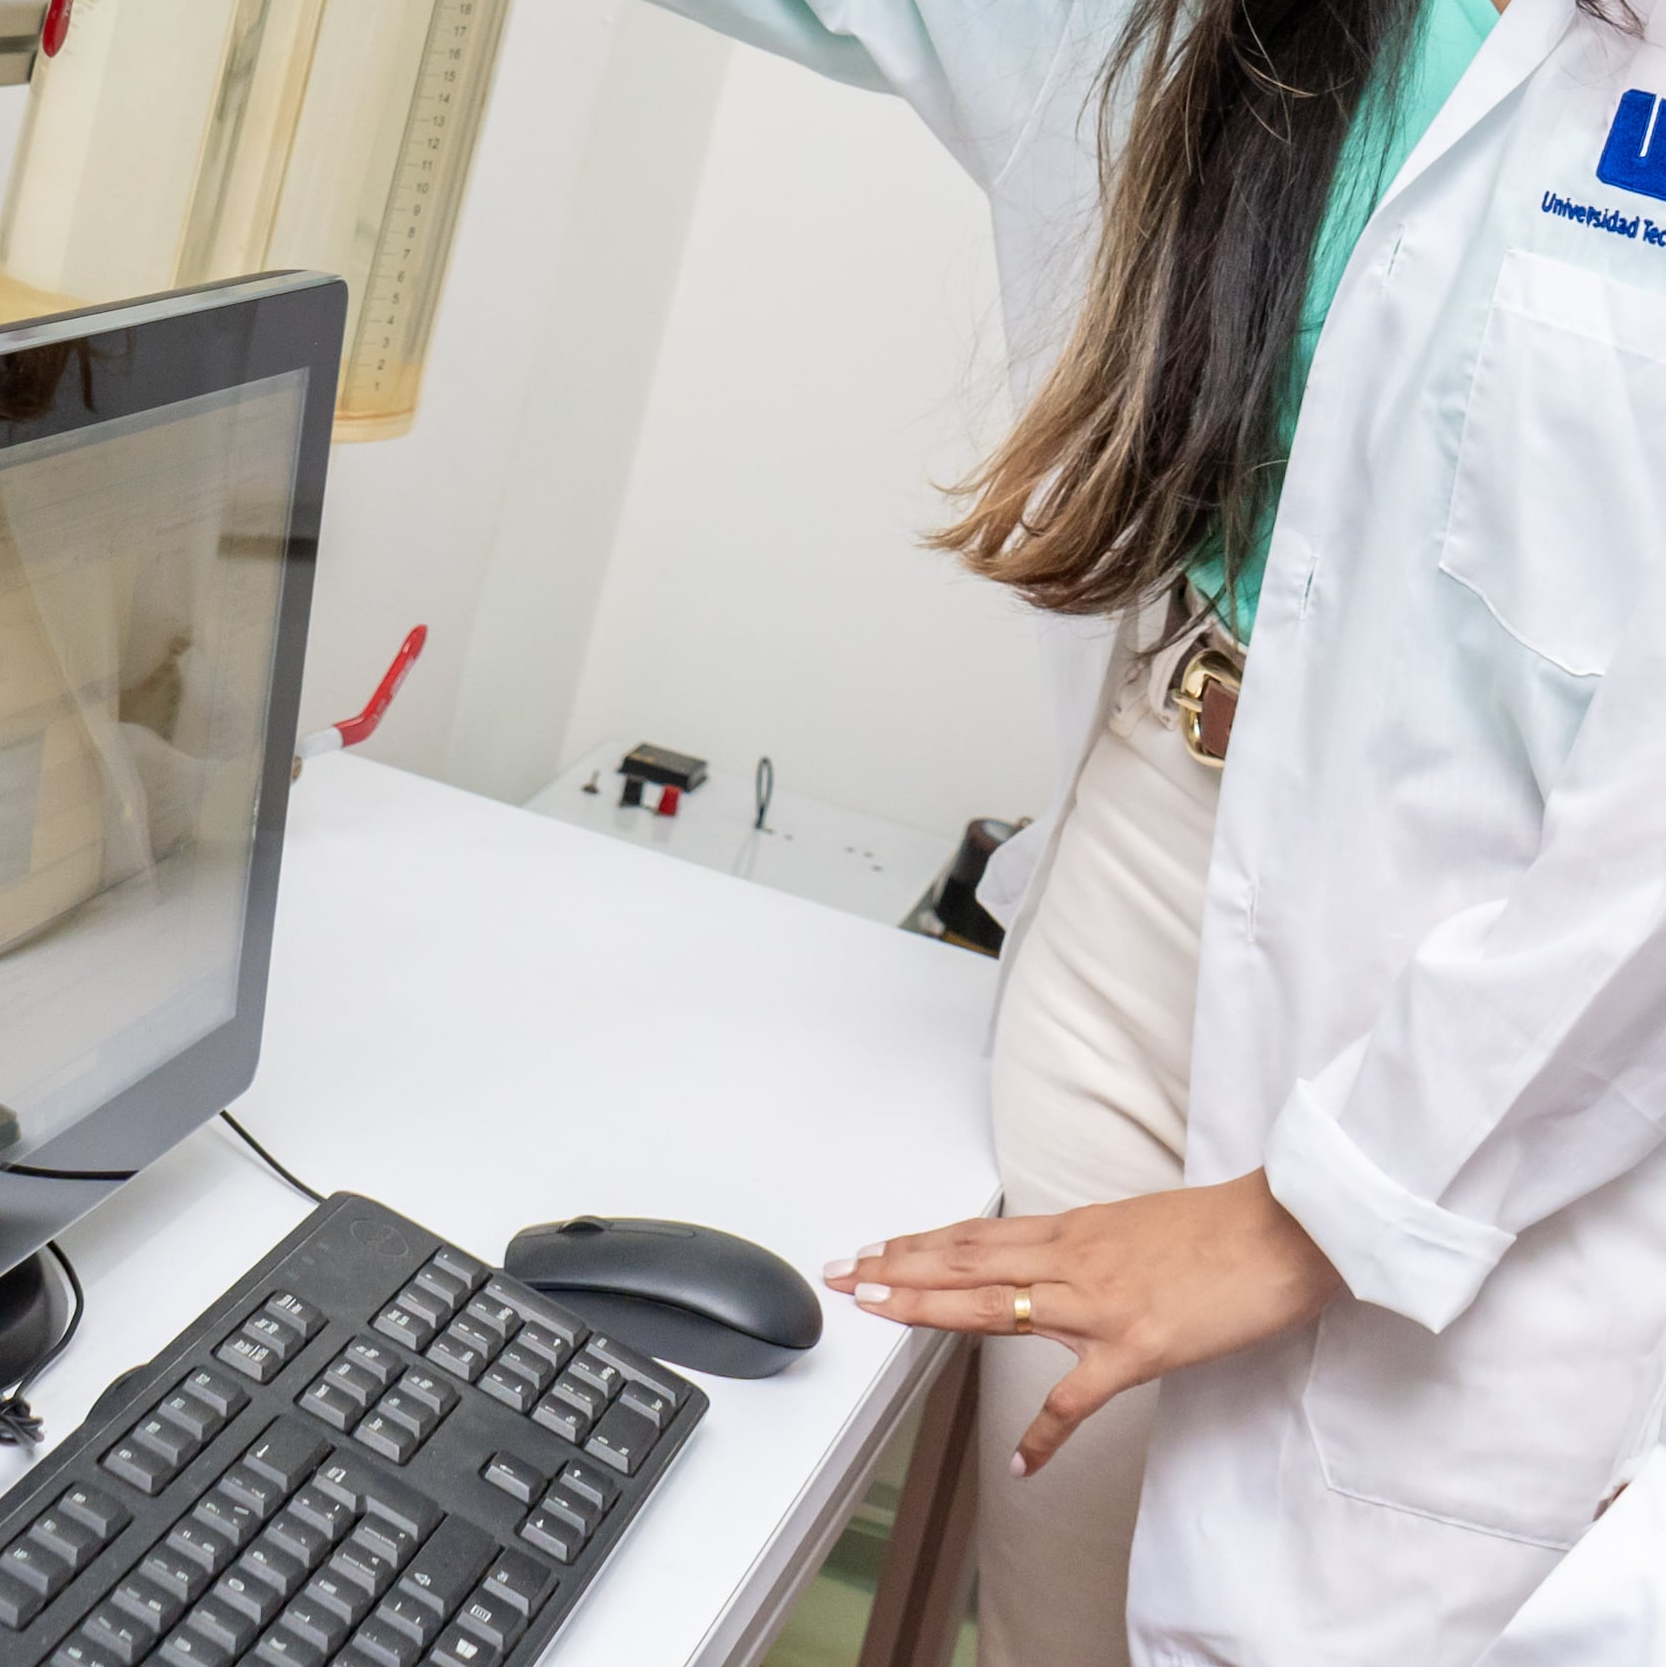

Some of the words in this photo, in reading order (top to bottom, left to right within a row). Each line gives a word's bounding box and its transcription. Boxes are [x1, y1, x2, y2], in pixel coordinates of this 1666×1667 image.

[460, 4, 472, 15] 18
[455, 26, 467, 37] 17
[449, 48, 461, 59] 16
[444, 71, 456, 82] 15
[438, 93, 450, 104] 14
[433, 116, 445, 127] 13
[428, 138, 440, 150] 12
[422, 160, 433, 170] 11
[417, 182, 429, 194] 10
[1541, 190, 1640, 239] Universidad
